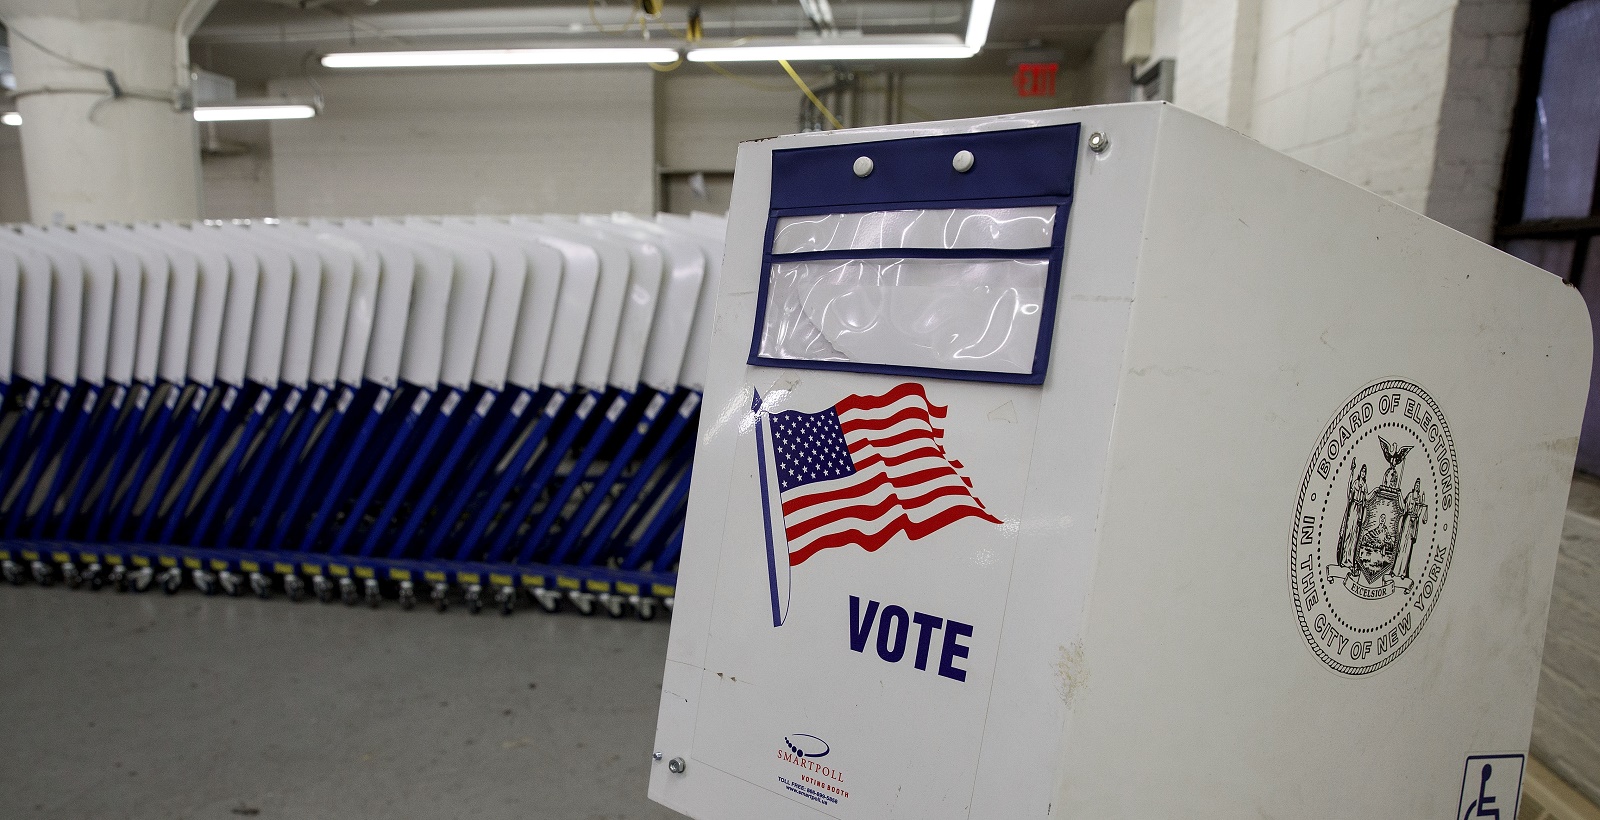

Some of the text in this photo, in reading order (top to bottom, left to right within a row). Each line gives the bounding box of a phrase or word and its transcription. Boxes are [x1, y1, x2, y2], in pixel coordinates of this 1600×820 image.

[1018, 63, 1058, 97] EXIT
[1317, 394, 1453, 511] BOARD OF ELECTIONS
[1300, 515, 1447, 660] IN THE CITY OF NEW YORK
[1350, 583, 1388, 598] EXCELSIOR
[849, 595, 974, 683] VOTE
[777, 749, 844, 783] SMARTPOLL
[778, 776, 791, 786] TOLL
[801, 774, 849, 798] VOTING BOOTH
